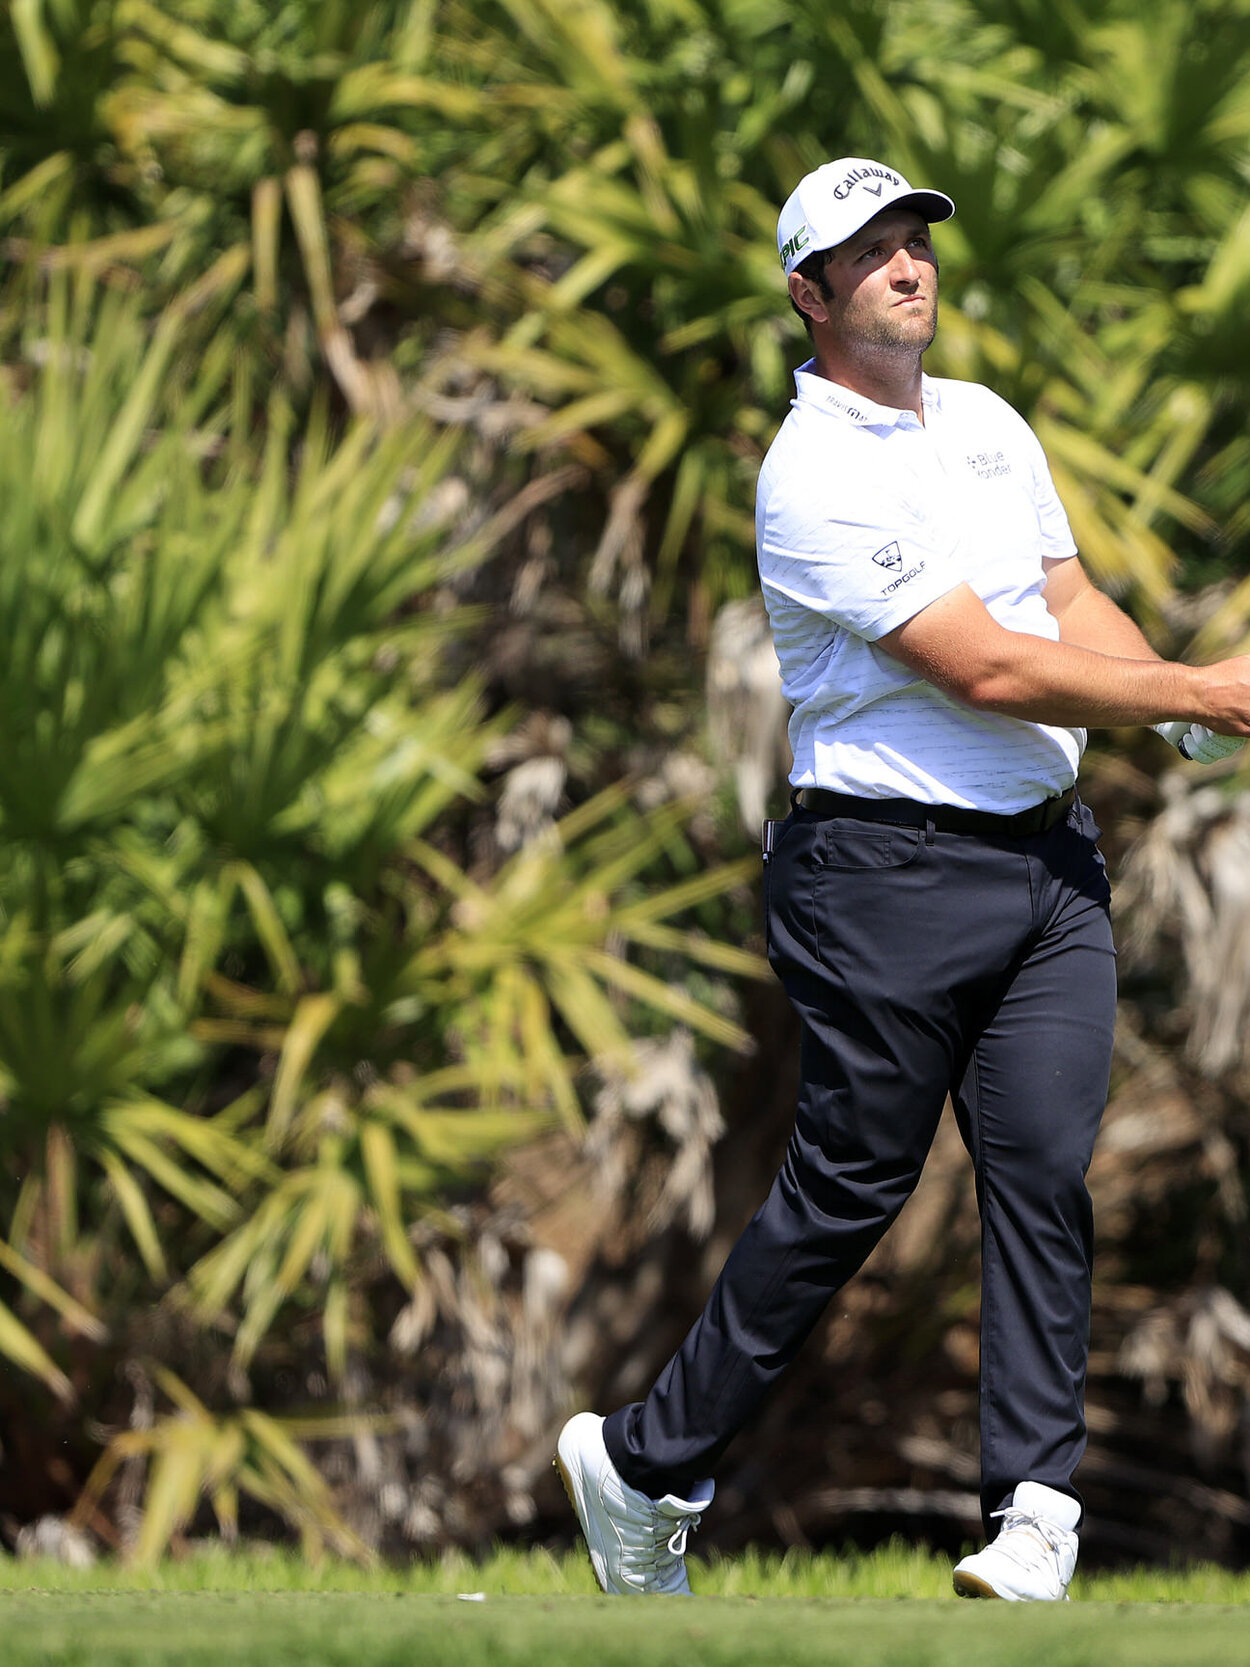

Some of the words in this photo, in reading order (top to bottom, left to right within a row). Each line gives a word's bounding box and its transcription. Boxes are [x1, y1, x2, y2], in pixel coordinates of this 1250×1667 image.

[833, 167, 900, 200] Callaway
[780, 225, 809, 270] PIC
[977, 451, 1005, 466] Blue
[880, 560, 926, 596] TOPGOLF
